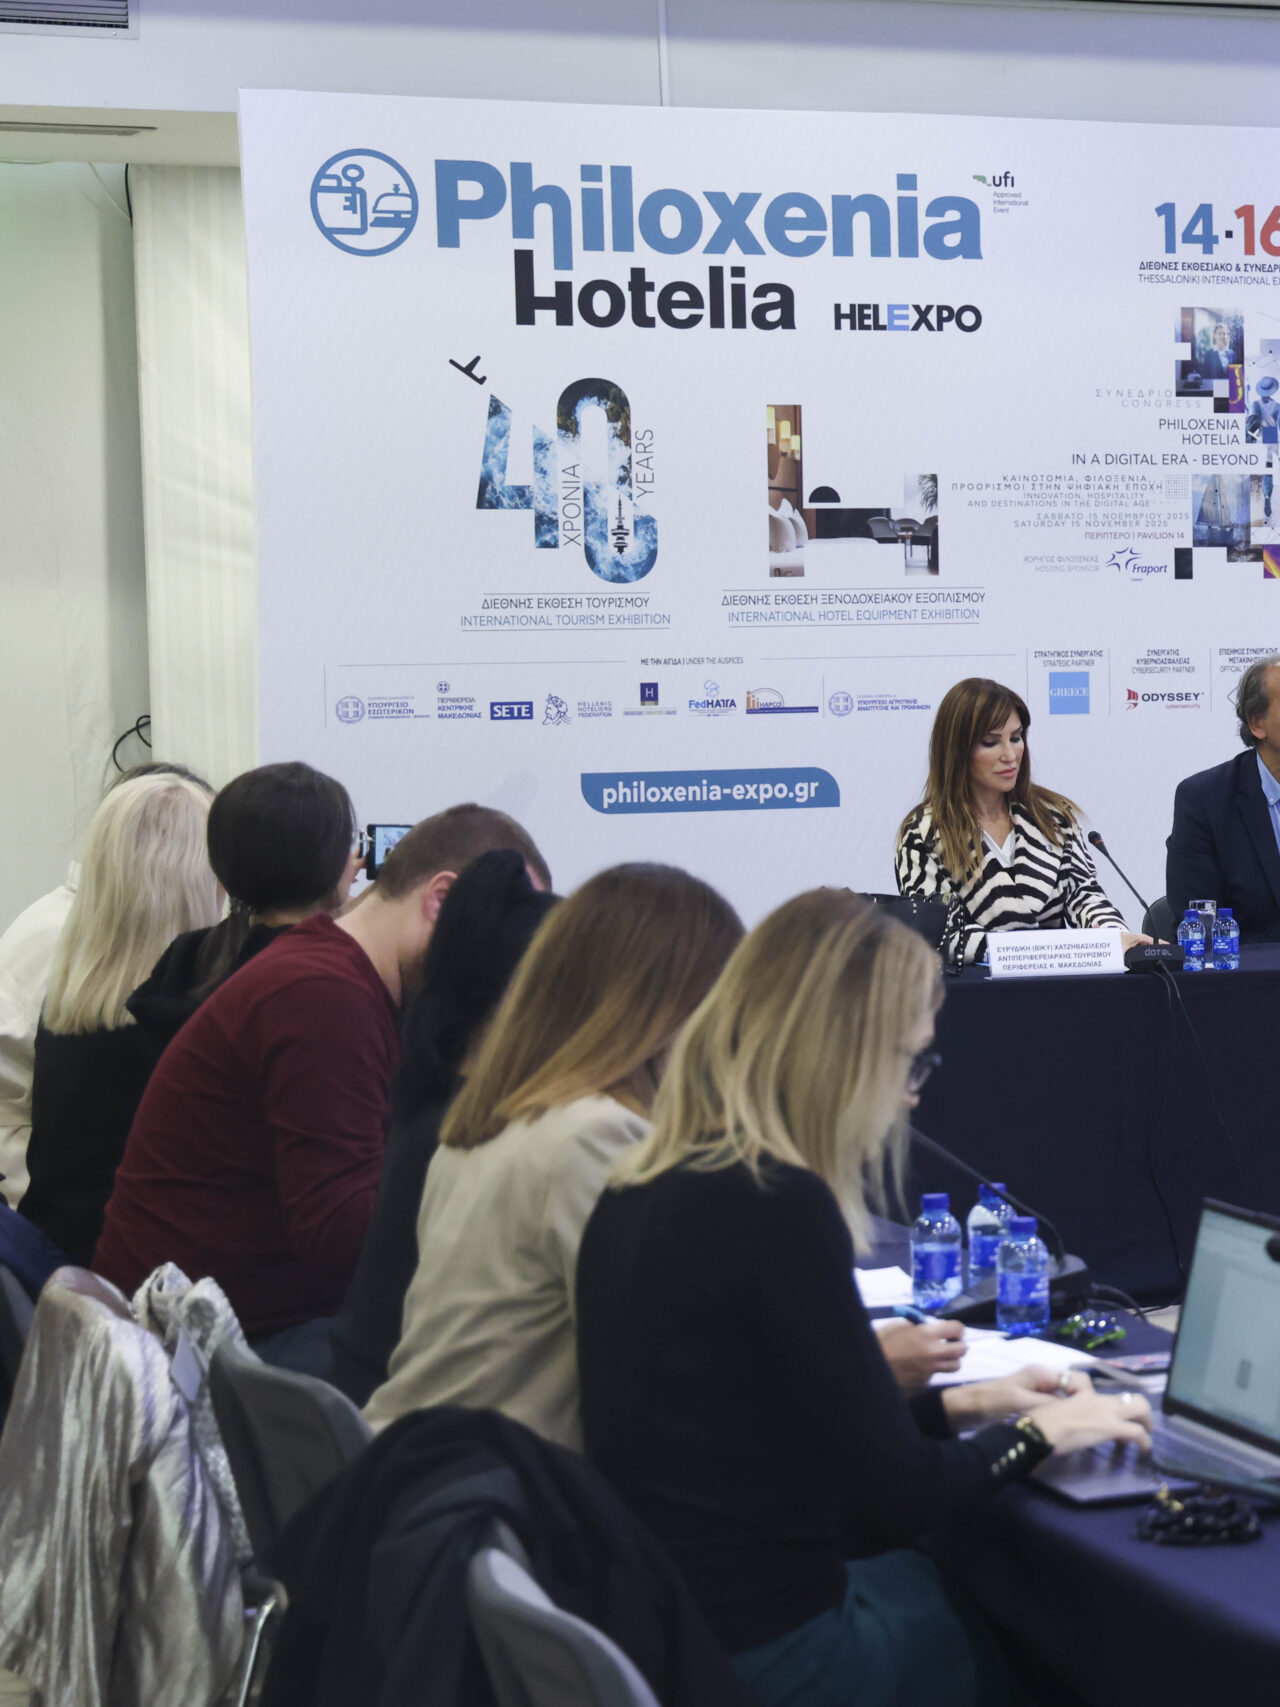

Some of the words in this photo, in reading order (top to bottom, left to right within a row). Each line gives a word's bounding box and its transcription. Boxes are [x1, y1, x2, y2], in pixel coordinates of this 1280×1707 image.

[992, 171, 1015, 187] ufi
[435, 159, 983, 270] Philoxenia
[1139, 262, 1179, 271] ΔΙΕΘΝΕΣ
[1182, 263, 1233, 272] ΕΚΘΕΣΙΑΚΟ
[1235, 263, 1241, 272] &
[1138, 274, 1200, 284] THESSALONIKI
[1202, 275, 1270, 285] INTERNATIONAL
[514, 249, 796, 331] Hotelia
[834, 303, 982, 332] HELEXPO
[1095, 389, 1172, 398] ΣΥΝΕΔΡΙΟ
[1121, 399, 1202, 408] CONGRESS
[1158, 418, 1240, 430] PHILOXENIA
[1181, 433, 1240, 446] HOTELIA
[634, 429, 654, 498] YEARS
[1072, 454, 1088, 465] IN
[1090, 454, 1101, 465] A
[1104, 454, 1158, 465] DIGITAL
[1162, 454, 1189, 465] ERA
[1202, 454, 1259, 466] BEYOND
[561, 463, 582, 547] ΧΡΟΝΙΑ
[1132, 563, 1168, 576] Fraport
[481, 598, 534, 609] ΔΙΕΘΝΗΣ
[537, 598, 583, 609] ΕΚΘΕΣΗ
[586, 597, 650, 608] ΤΟΥΡΙΣΜΟΥ
[721, 595, 771, 606] ΔΙΕΘΝΗΣ
[775, 594, 818, 605] ΕΚΘΕΣΗ
[821, 593, 912, 605] ΞΕΝΟΔΟΧΕΙΑΚΟΥ
[915, 592, 986, 604] ΕΞΟΠΛΙΣΜΟΥ
[460, 615, 552, 626] INTERNATIONAL
[556, 614, 604, 625] TOURISM
[608, 614, 671, 624] EXHIBITION
[728, 611, 815, 622] INTERNATIONAL
[818, 610, 854, 621] HOTEL
[856, 609, 918, 620] EQUIPMENT
[921, 609, 980, 620] EXHIBITION
[1050, 687, 1090, 697] GREECE
[1141, 692, 1200, 702] ODYSSEY
[493, 704, 531, 717] SETE
[602, 779, 820, 809] philoxenia-expo.gr
